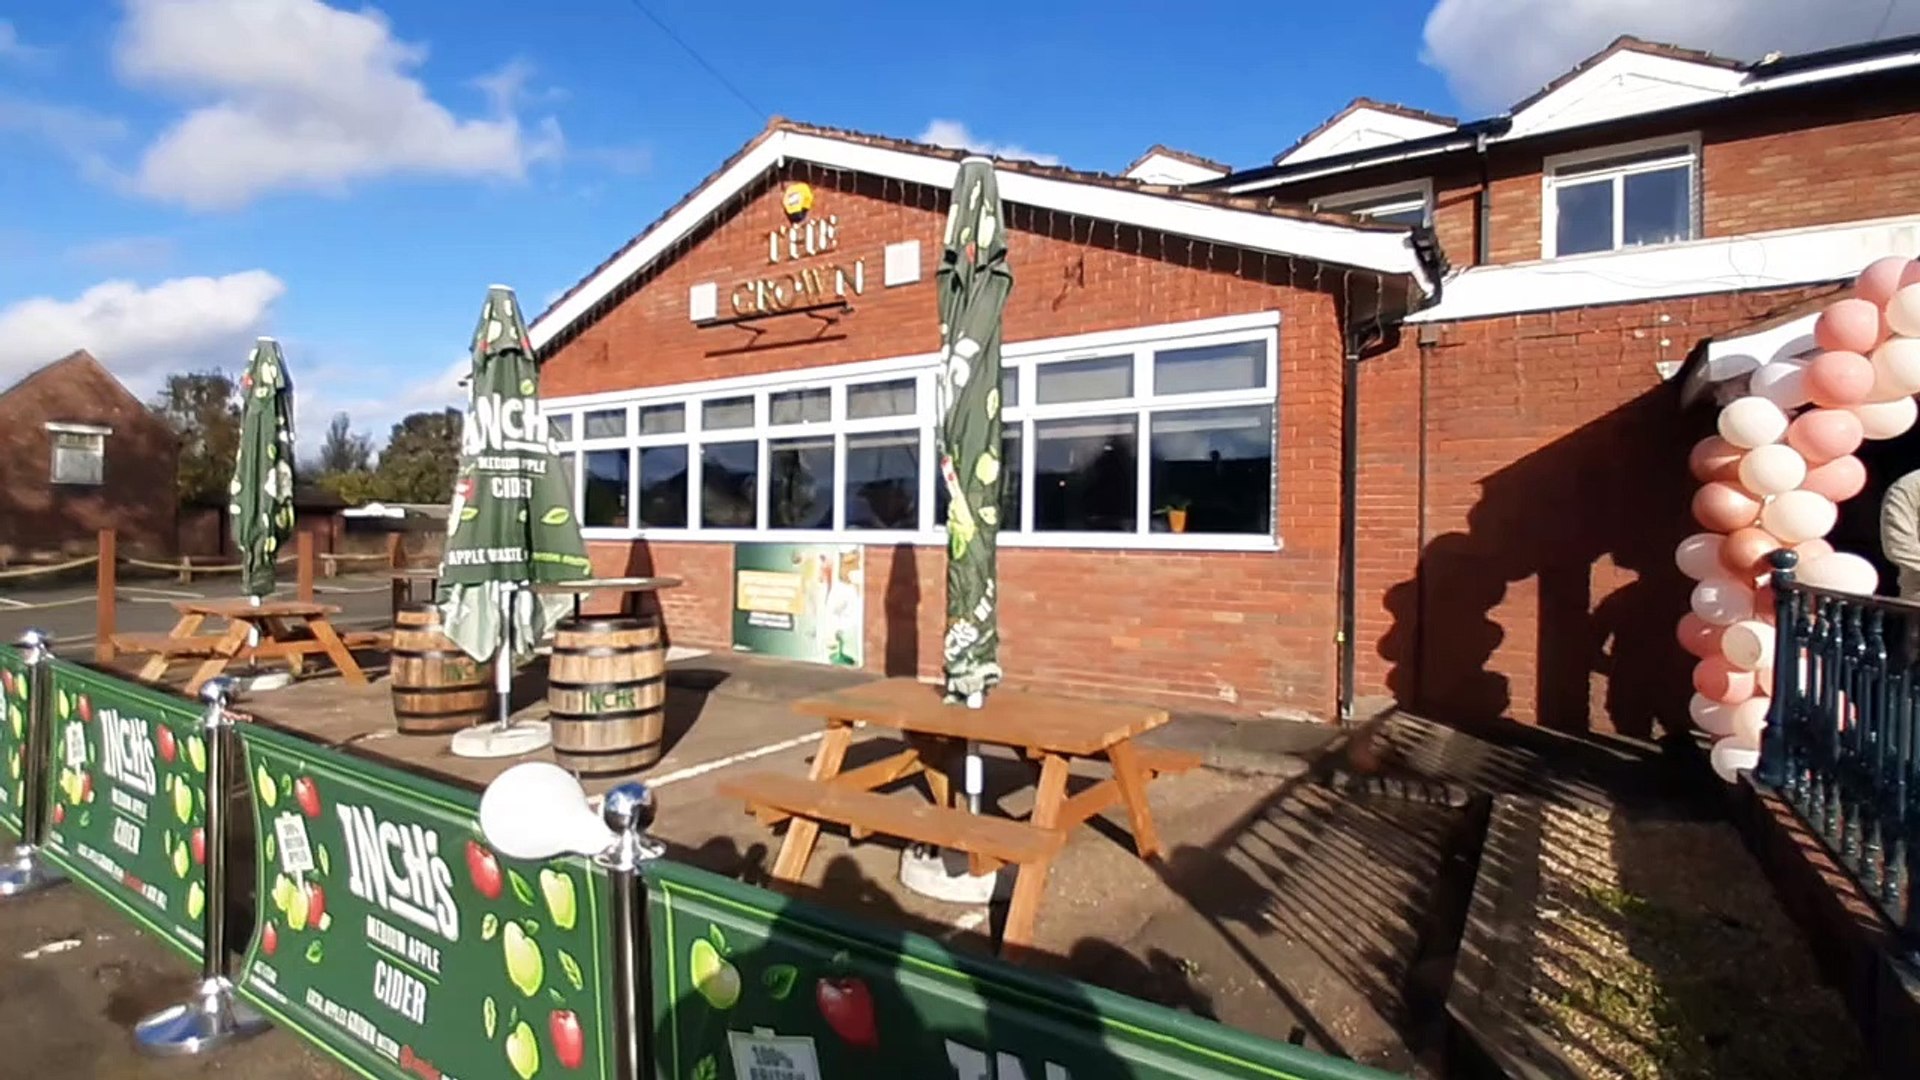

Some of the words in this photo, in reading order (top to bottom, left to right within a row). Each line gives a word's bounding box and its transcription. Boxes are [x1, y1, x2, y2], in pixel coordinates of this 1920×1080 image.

[766, 214, 839, 264] THE
[731, 257, 865, 315] CROWN
[449, 549, 486, 565] APPLE
[408, 936, 441, 974] APPLE
[374, 960, 427, 1025] CIDER
[751, 1044, 794, 1069] 100%
